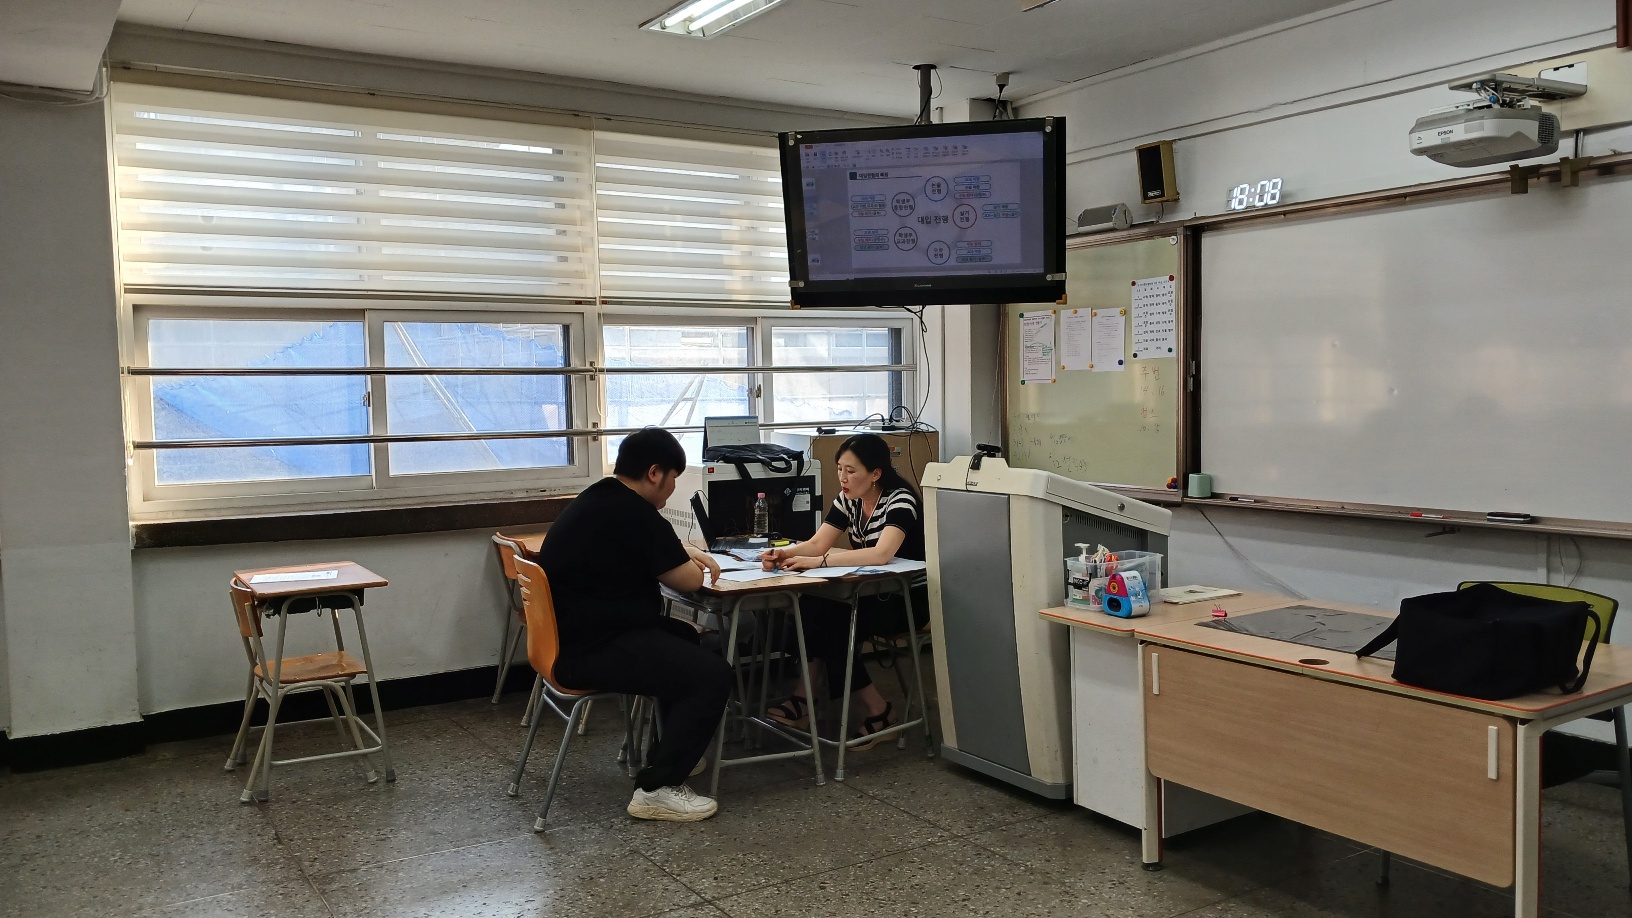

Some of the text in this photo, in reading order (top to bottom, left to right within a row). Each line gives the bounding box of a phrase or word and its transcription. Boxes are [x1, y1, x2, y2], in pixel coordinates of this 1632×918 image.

[1437, 129, 1454, 137] EPSON
[1231, 177, 1283, 210] 18:08
[917, 214, 949, 225] 대입 전형
[1140, 366, 1160, 381] 주번
